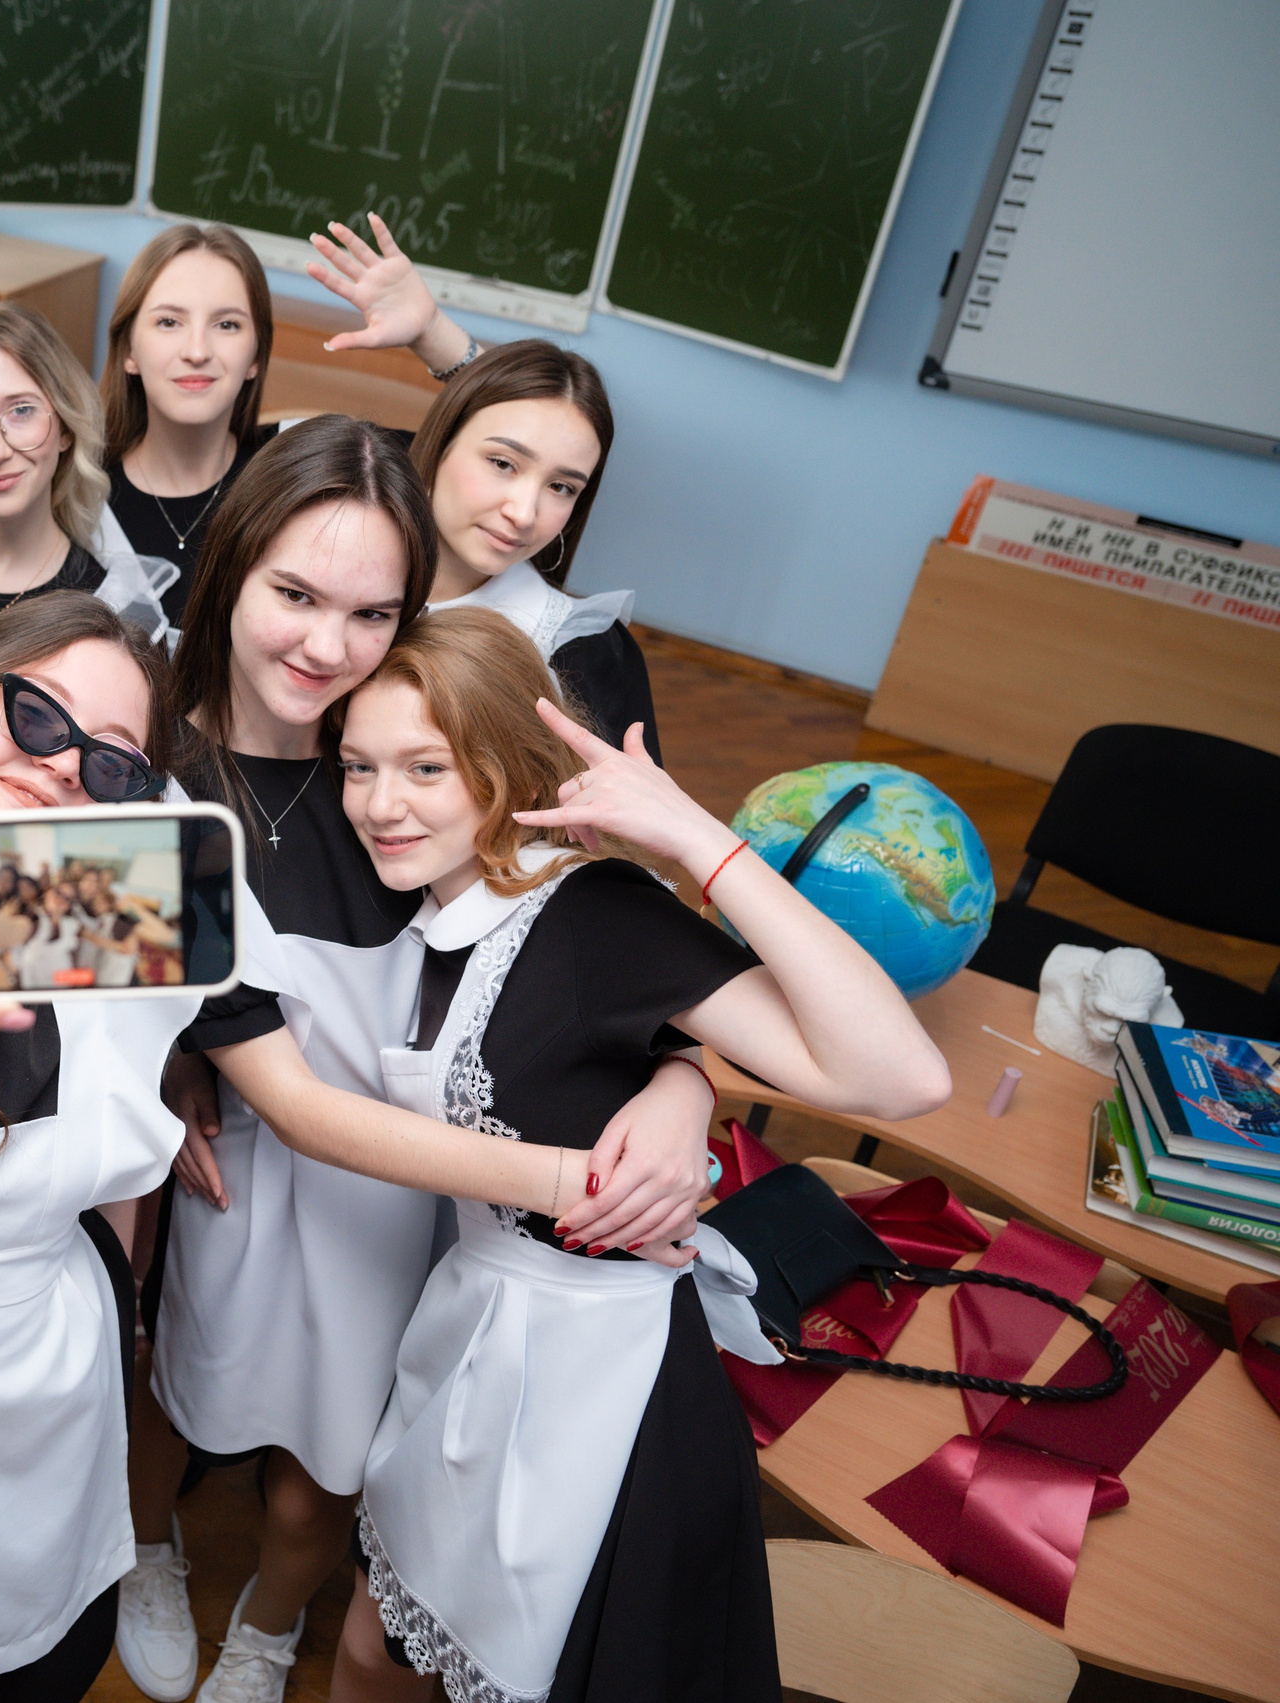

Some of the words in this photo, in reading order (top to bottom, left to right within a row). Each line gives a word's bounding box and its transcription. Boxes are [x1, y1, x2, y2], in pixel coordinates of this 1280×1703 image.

[346, 181, 466, 253] 2025
[1042, 552, 1147, 591] ПИШЕТСЯ
[1103, 548, 1280, 606] ПРИЛАГАТЕЛЬН
[1144, 540, 1161, 557] В
[1173, 547, 1280, 588] СУФФИКС
